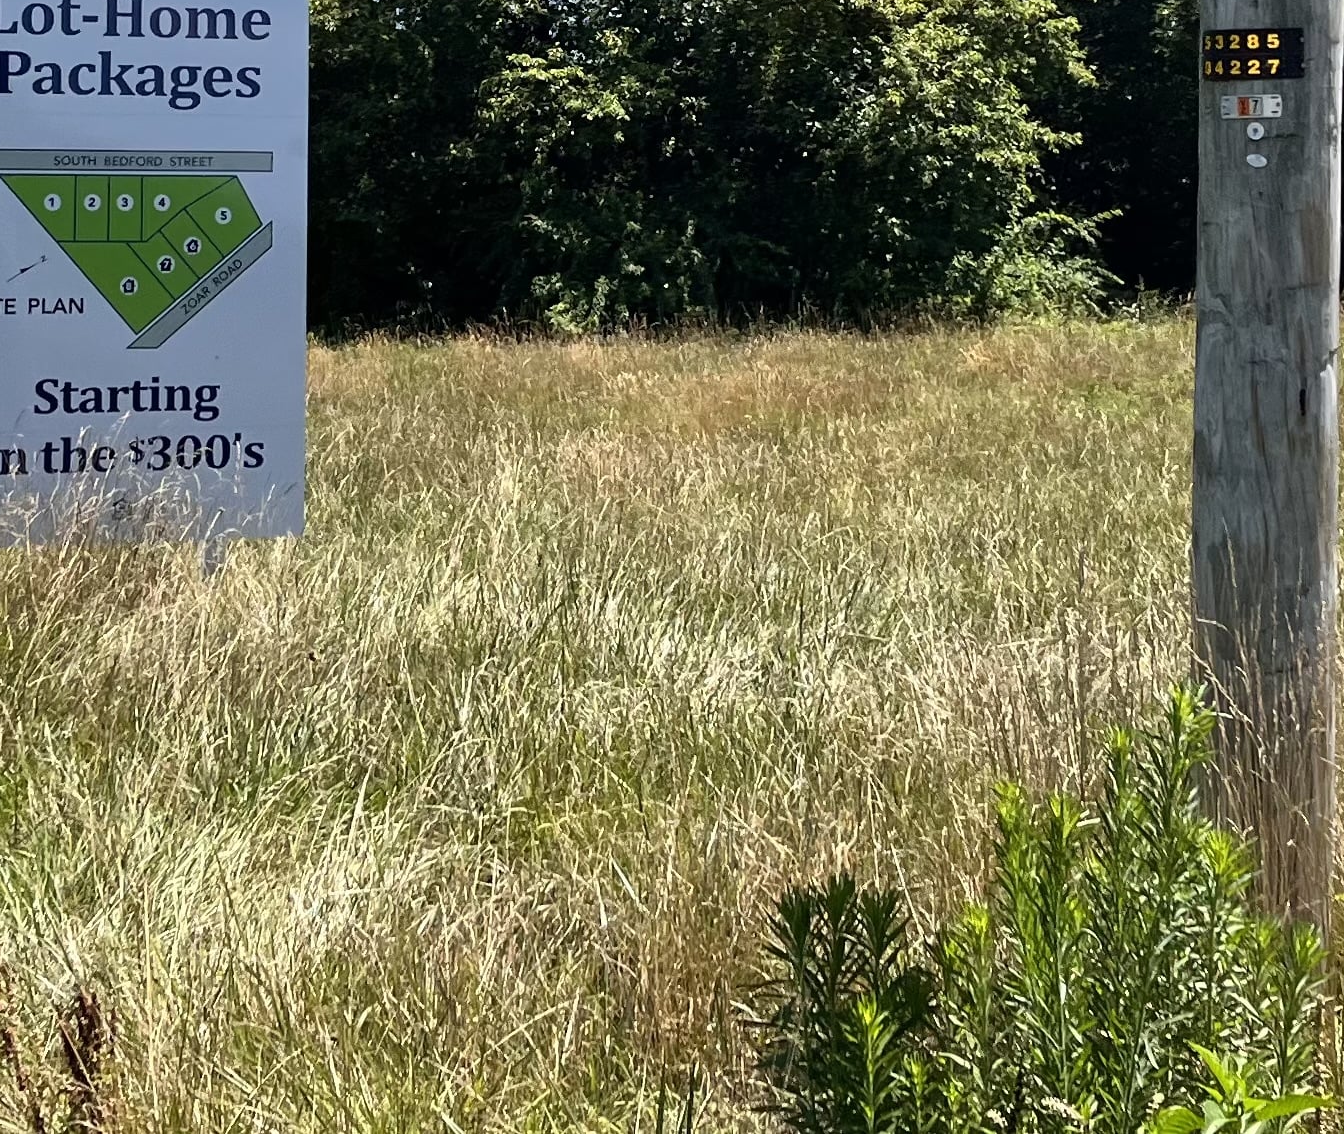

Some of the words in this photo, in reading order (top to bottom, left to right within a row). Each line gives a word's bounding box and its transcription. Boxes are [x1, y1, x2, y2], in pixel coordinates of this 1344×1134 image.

[1205, 34, 1279, 50] 53285
[53, 155, 97, 166] SOUTH
[104, 156, 163, 167] BEDFORD
[170, 156, 214, 167] STREET
[48, 197, 55, 207] 1
[88, 197, 96, 207] 2
[121, 197, 129, 207] 3
[158, 197, 166, 207] 4
[220, 211, 228, 221] 5
[180, 286, 211, 315] ZOAR
[212, 259, 242, 287] ROAD
[28, 298, 84, 314] PLAN
[34, 377, 220, 422] Starting
[41, 437, 116, 474] the
[129, 433, 264, 470] $300's
